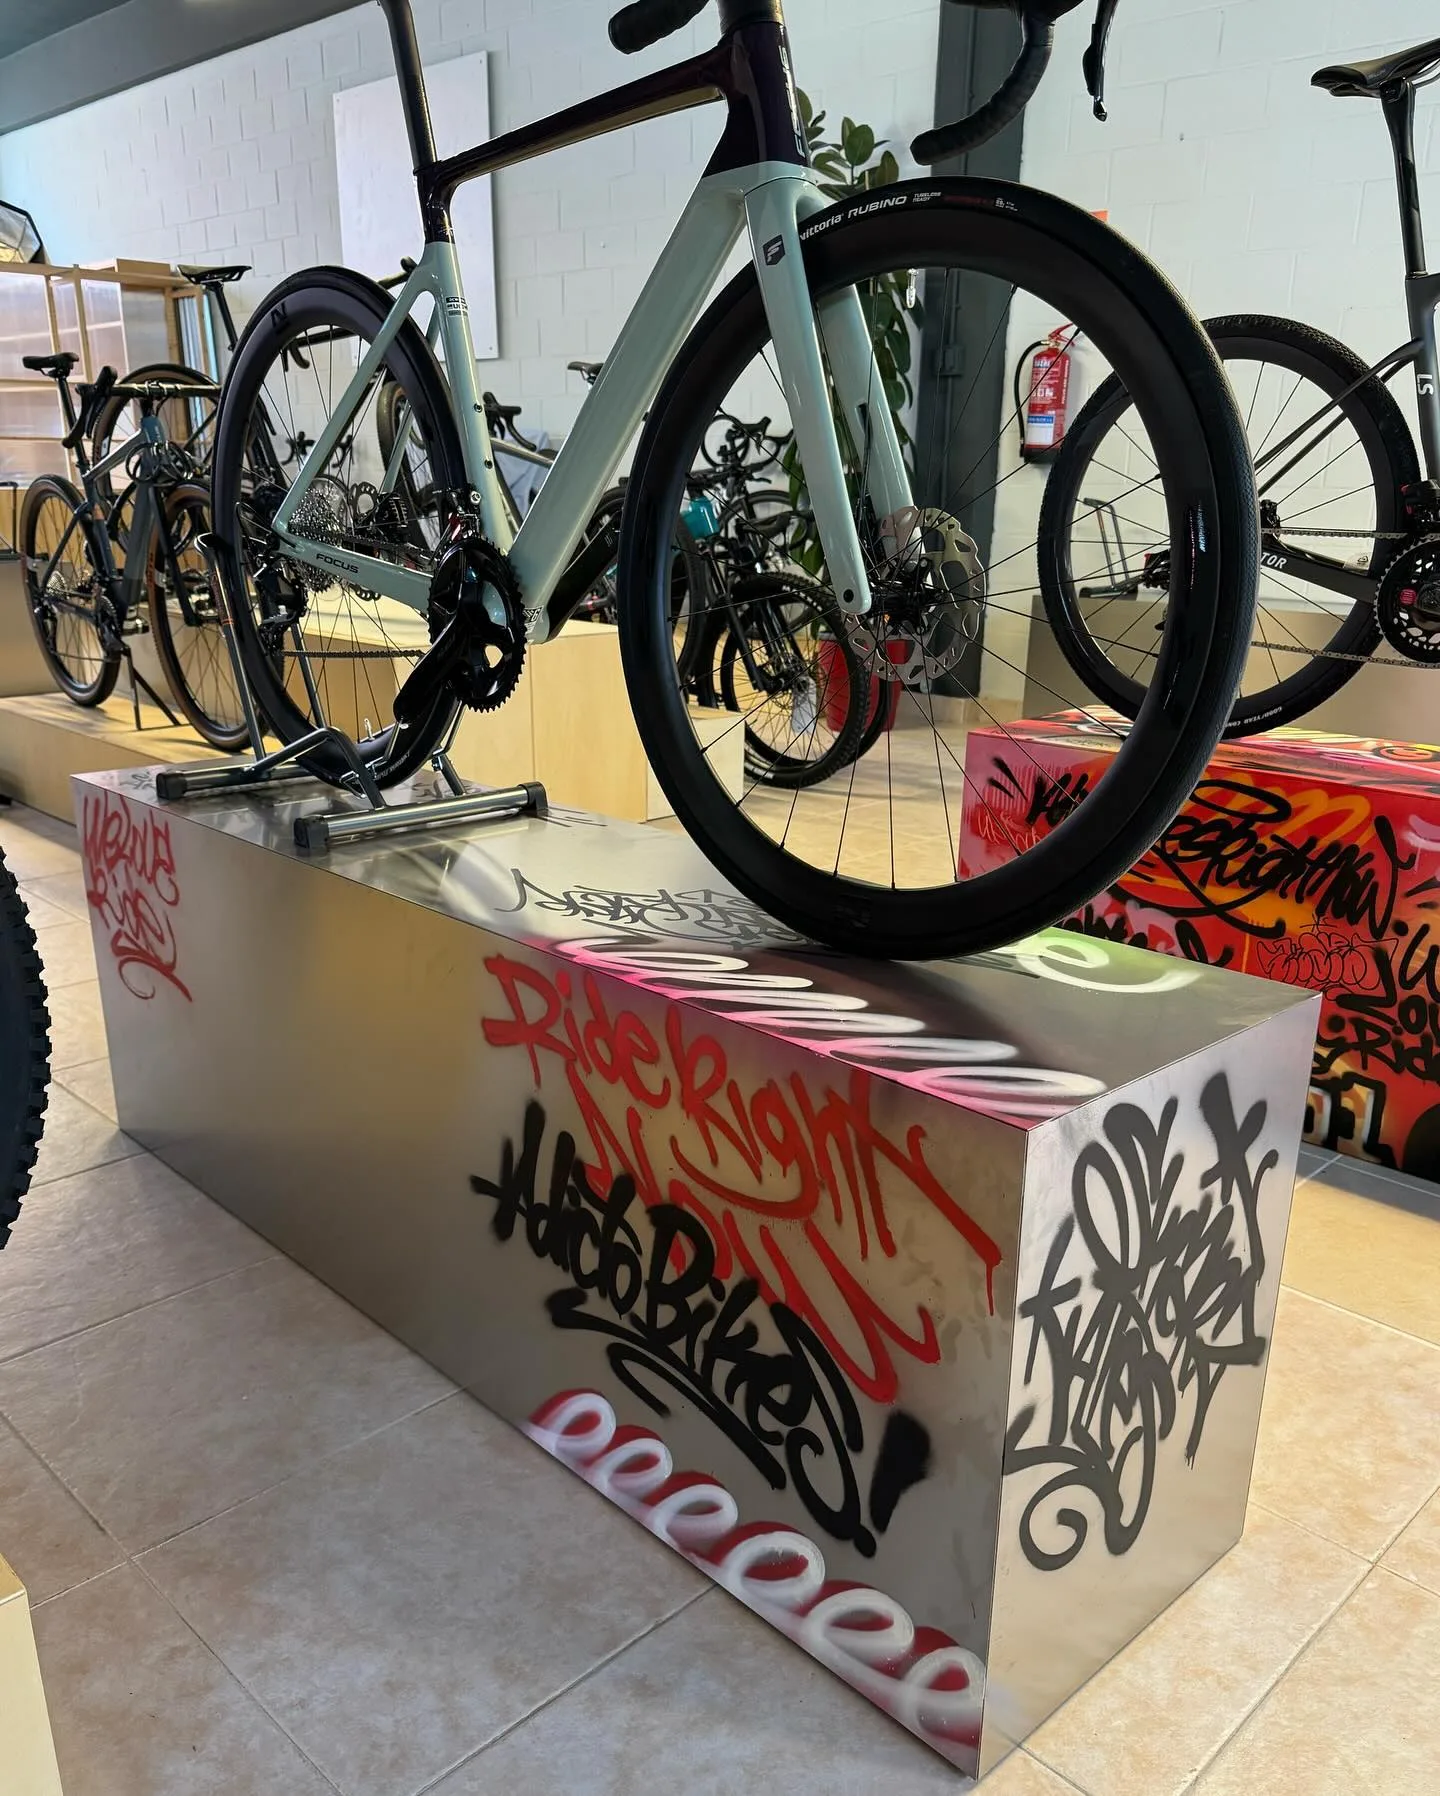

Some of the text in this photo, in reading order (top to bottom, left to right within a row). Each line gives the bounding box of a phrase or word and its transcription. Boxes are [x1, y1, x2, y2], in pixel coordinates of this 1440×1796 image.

[848, 195, 908, 219] RUBINO
[316, 553, 359, 574] FOCUS
[1260, 552, 1287, 569] TOR
[480, 953, 672, 1108] Ride
